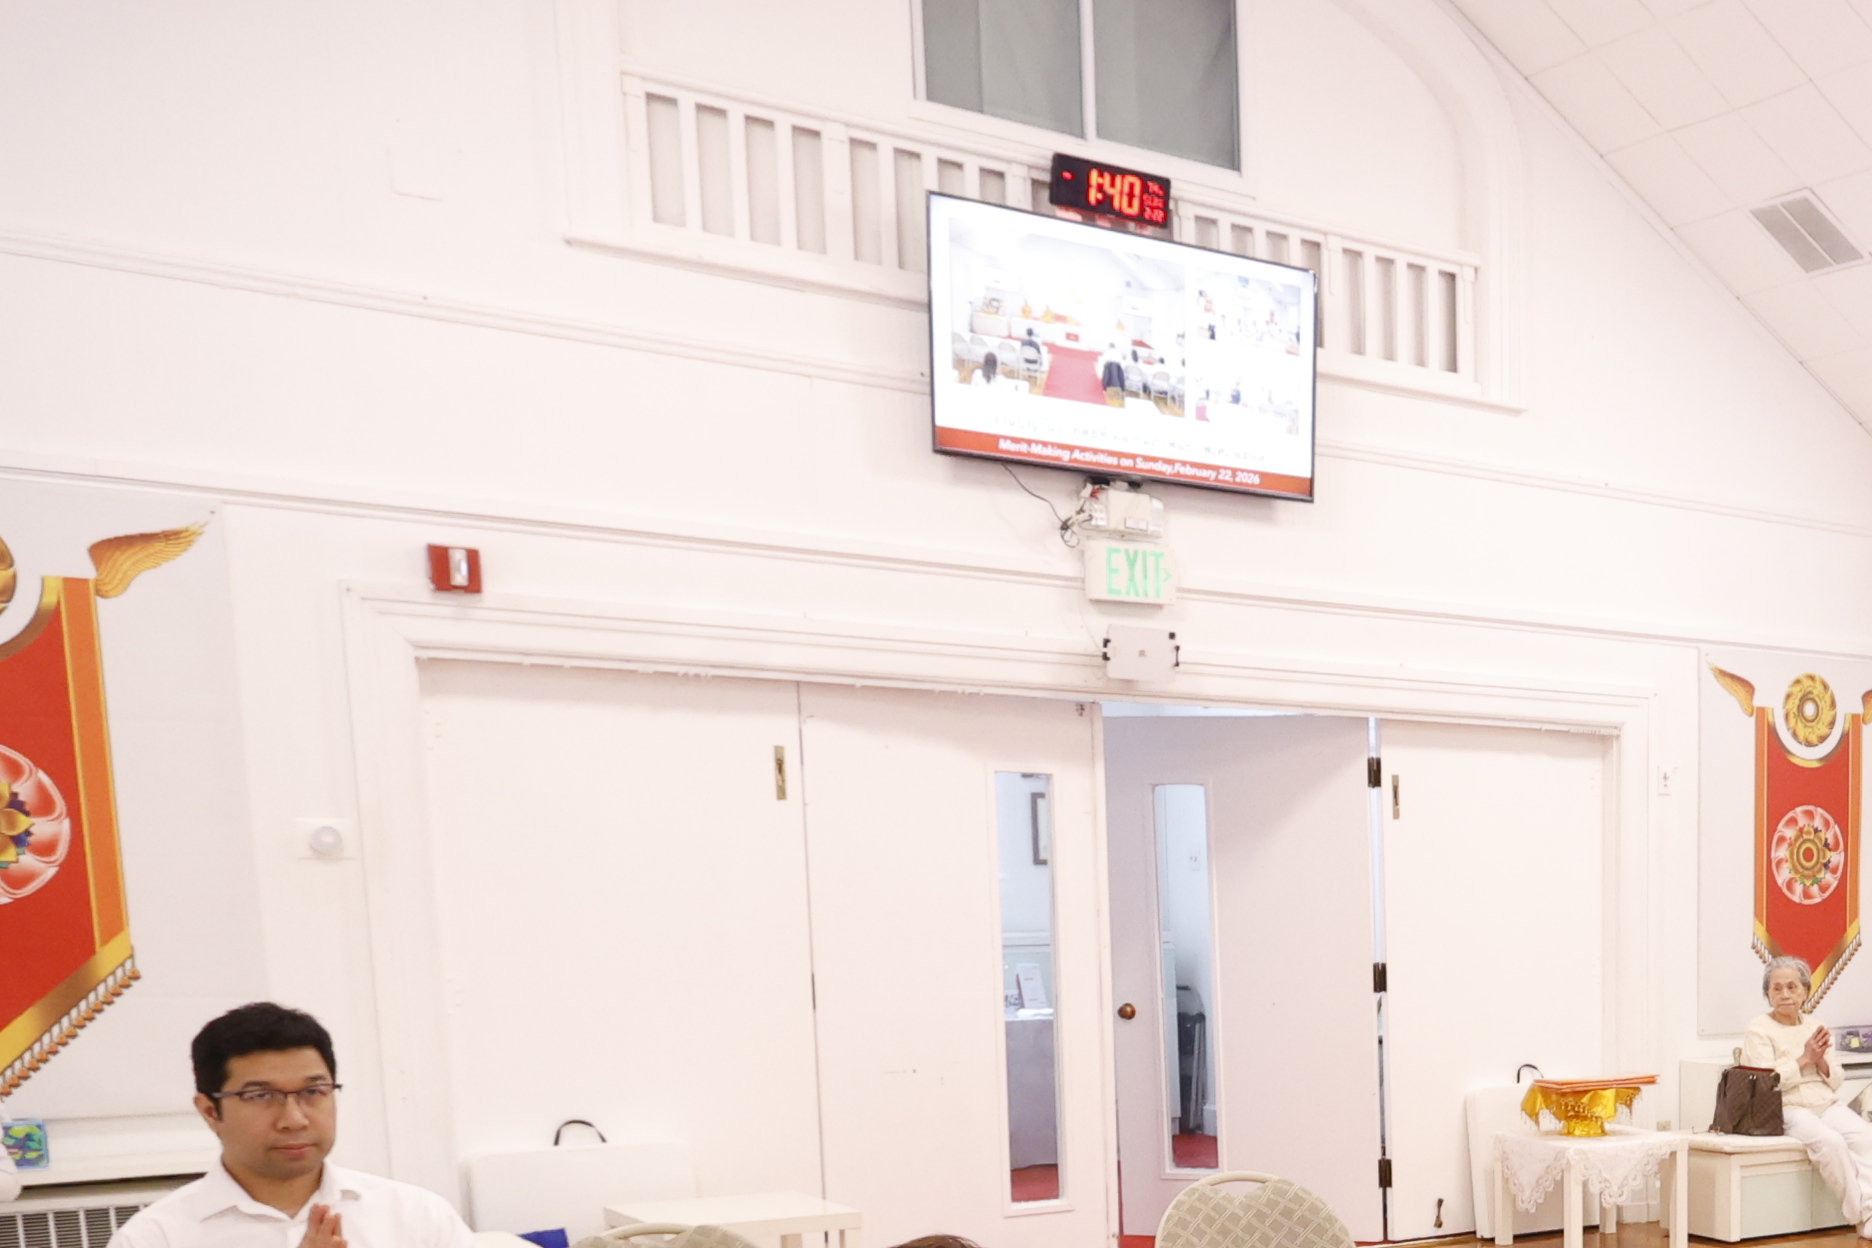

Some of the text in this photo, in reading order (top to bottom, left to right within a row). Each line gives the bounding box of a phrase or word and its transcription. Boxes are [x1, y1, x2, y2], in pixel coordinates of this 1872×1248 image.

[1088, 168, 1143, 217] 1:40
[998, 437, 1071, 462] Merit-Making
[1071, 448, 1119, 466] Activities
[1119, 457, 1135, 467] on
[1235, 471, 1261, 485] 2026
[1105, 546, 1165, 599] EXIT
